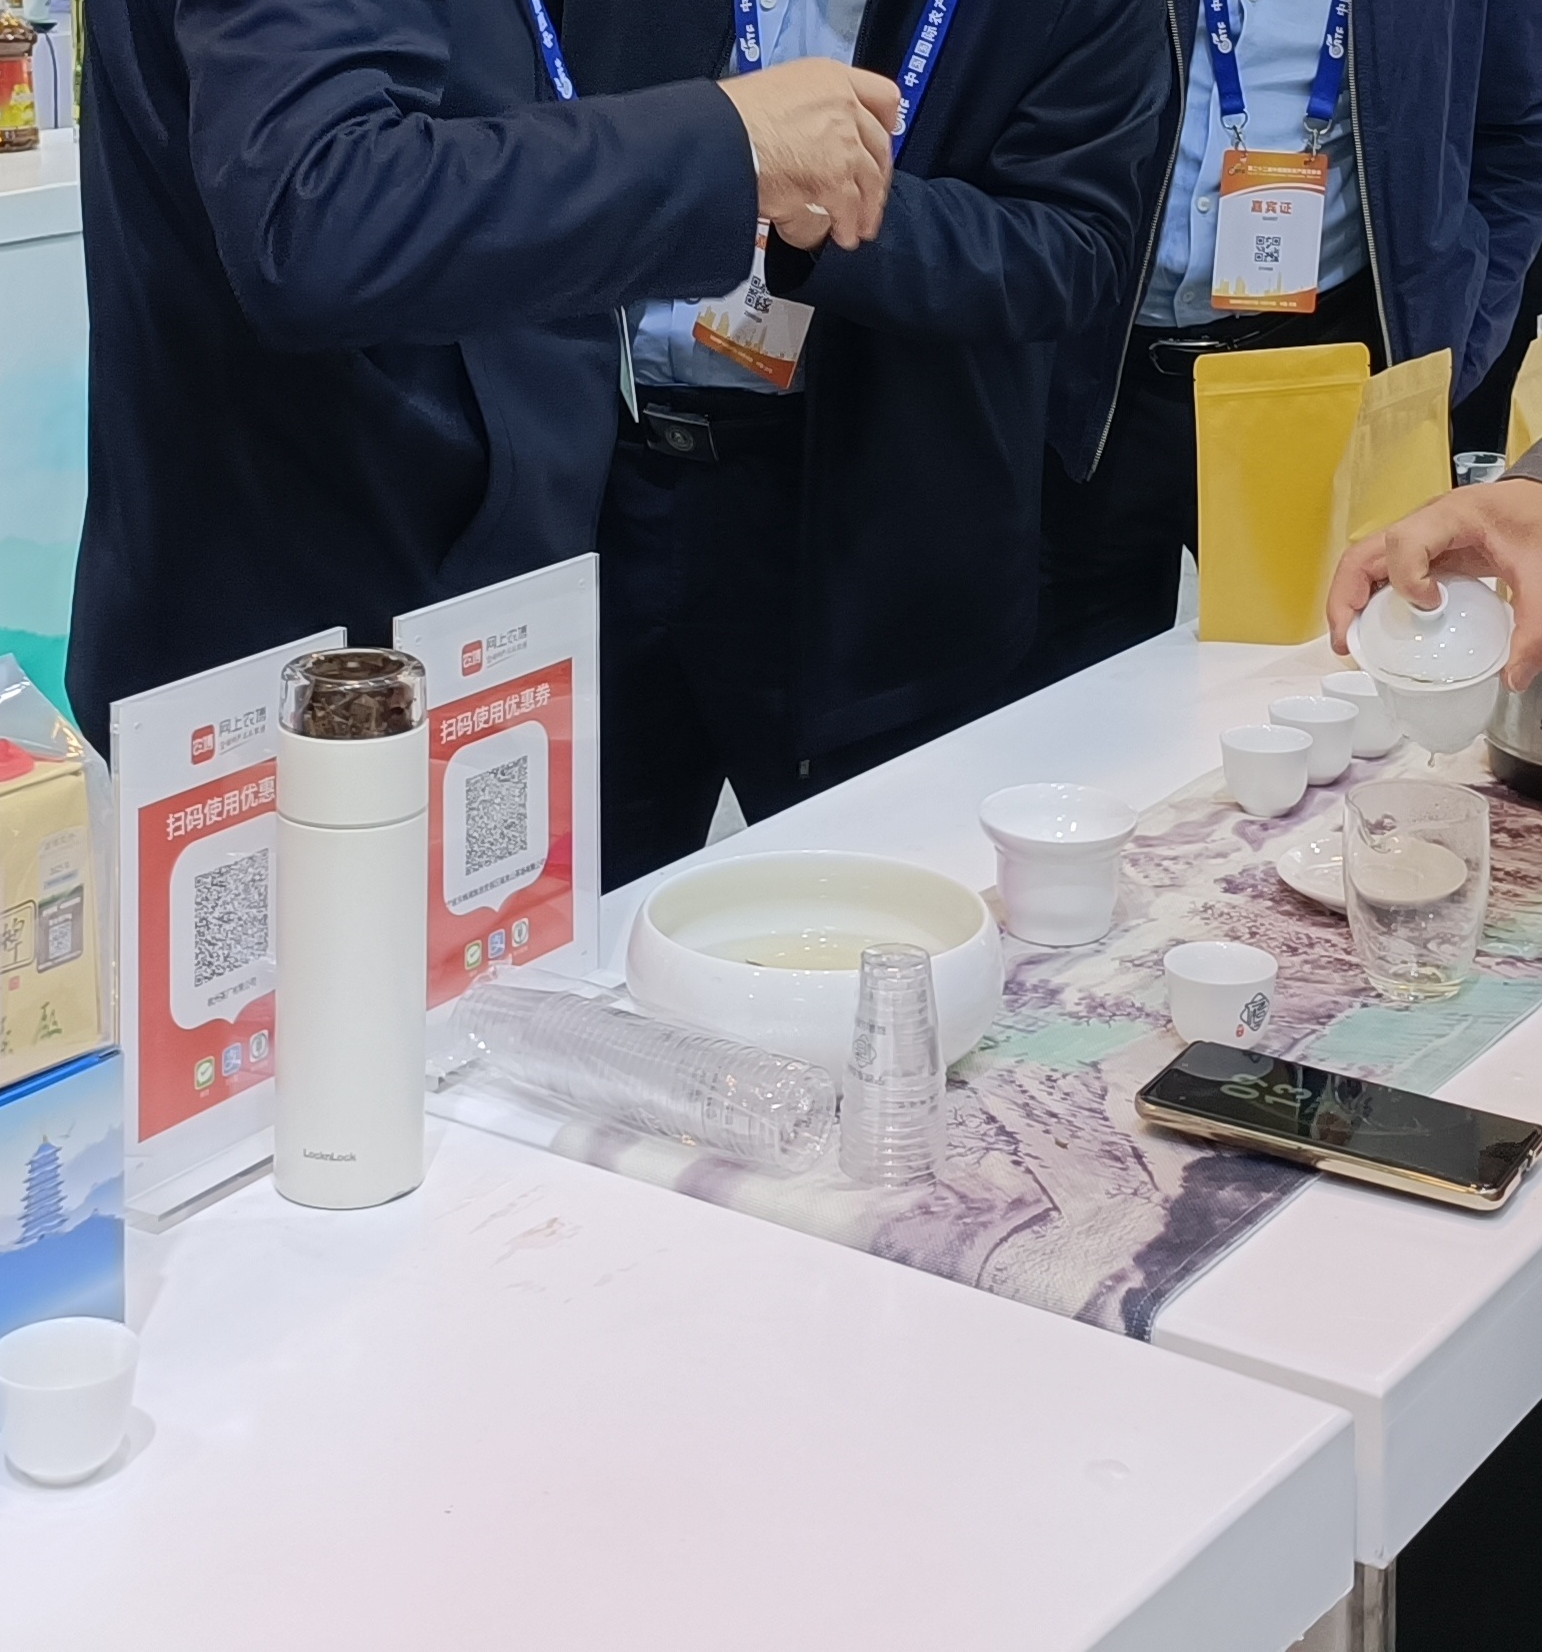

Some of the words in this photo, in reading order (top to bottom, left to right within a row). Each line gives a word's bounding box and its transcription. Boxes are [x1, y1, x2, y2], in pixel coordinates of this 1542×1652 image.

[1251, 199, 1292, 215] 嘉宾证
[440, 683, 551, 744] 扫码使用优惠券
